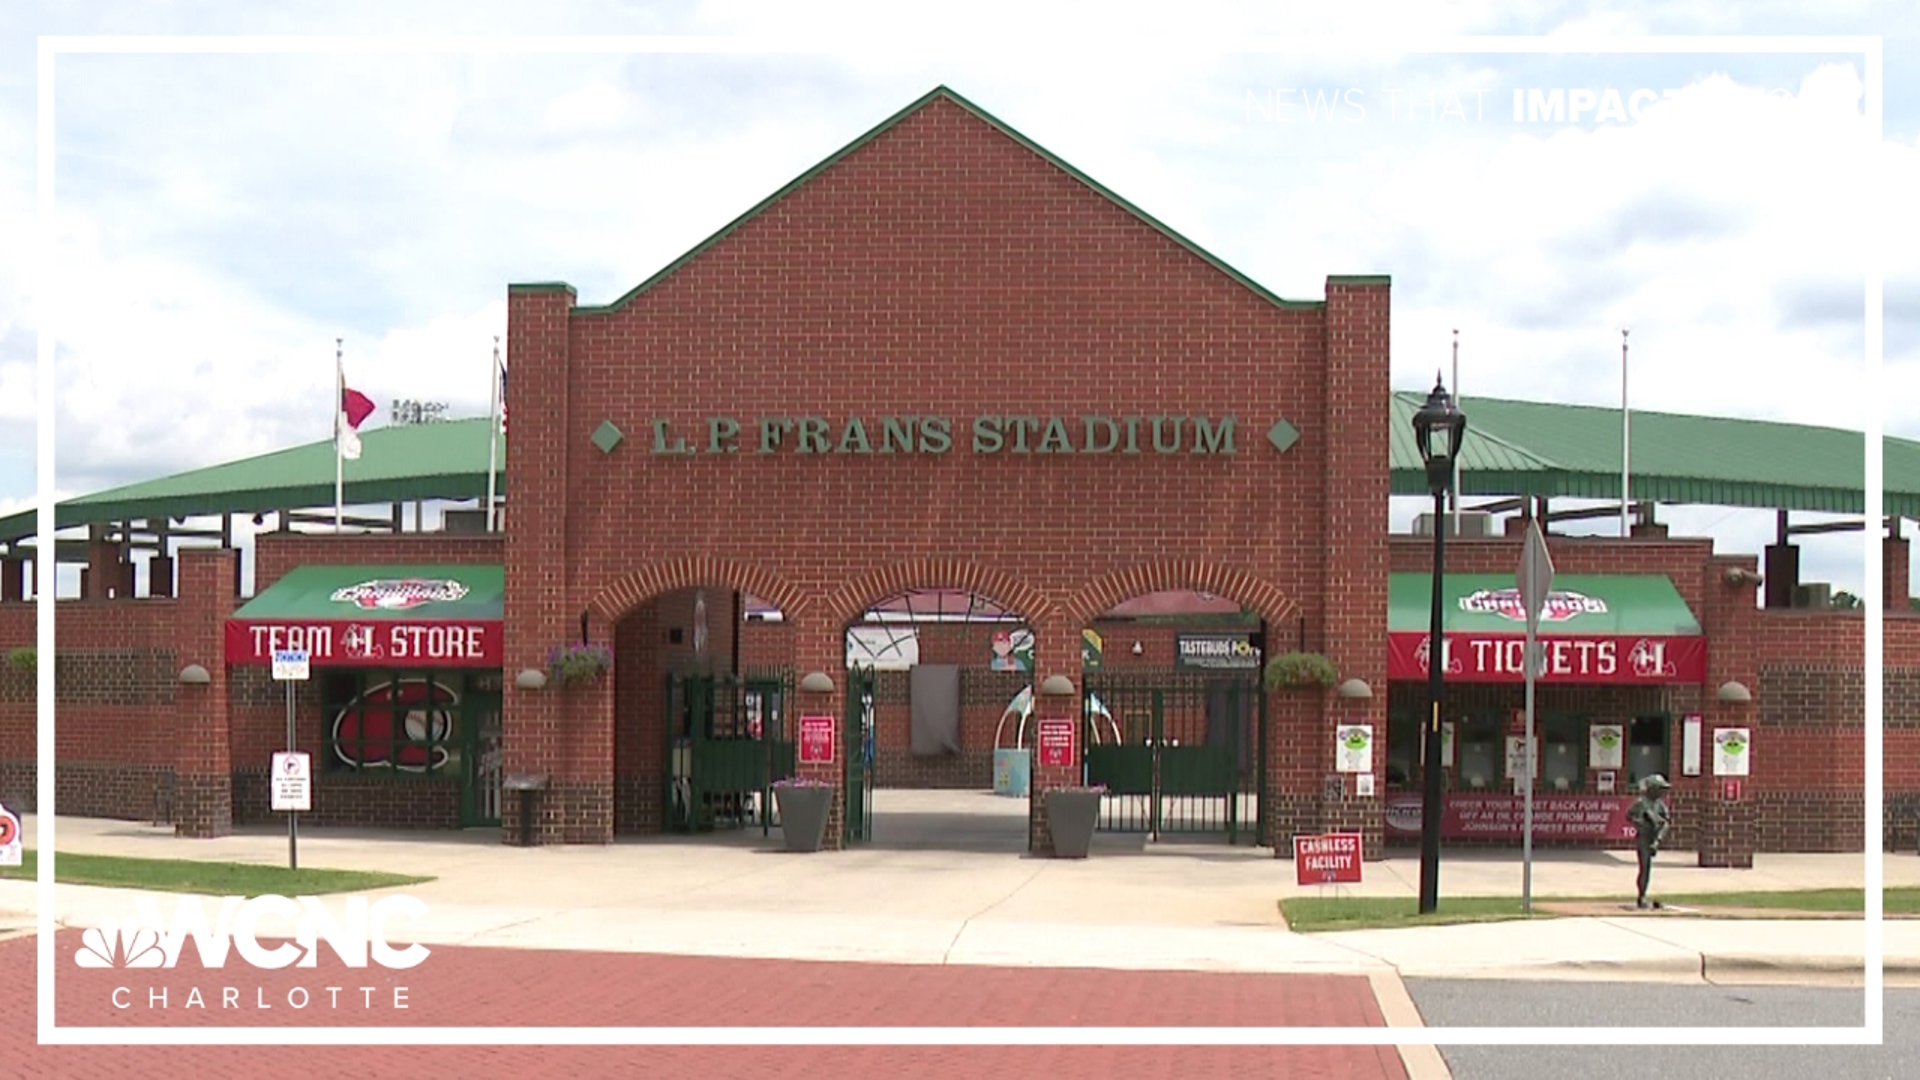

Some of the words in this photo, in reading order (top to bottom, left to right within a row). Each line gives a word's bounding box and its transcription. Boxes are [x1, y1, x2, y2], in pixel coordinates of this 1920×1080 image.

[757, 416, 952, 453] FRANS
[972, 416, 1238, 453] STADIUM
[249, 626, 332, 657] TEAM
[390, 626, 484, 657] STORE
[1470, 640, 1616, 674] TICETS
[1450, 800, 1484, 810] CHECK
[1486, 800, 1512, 810] YOUR
[1514, 800, 1549, 810] TIKET
[1549, 800, 1577, 811] BACK
[1579, 800, 1599, 811] FOR
[1480, 811, 1496, 821] AN
[1556, 812, 1584, 822] FROM
[1585, 812, 1610, 822] MIKE
[1519, 823, 1563, 833] EPRESS
[1565, 823, 1608, 833] SERVICE
[1300, 838, 1356, 854] CASHLESS
[1305, 856, 1352, 871] FACILITY
